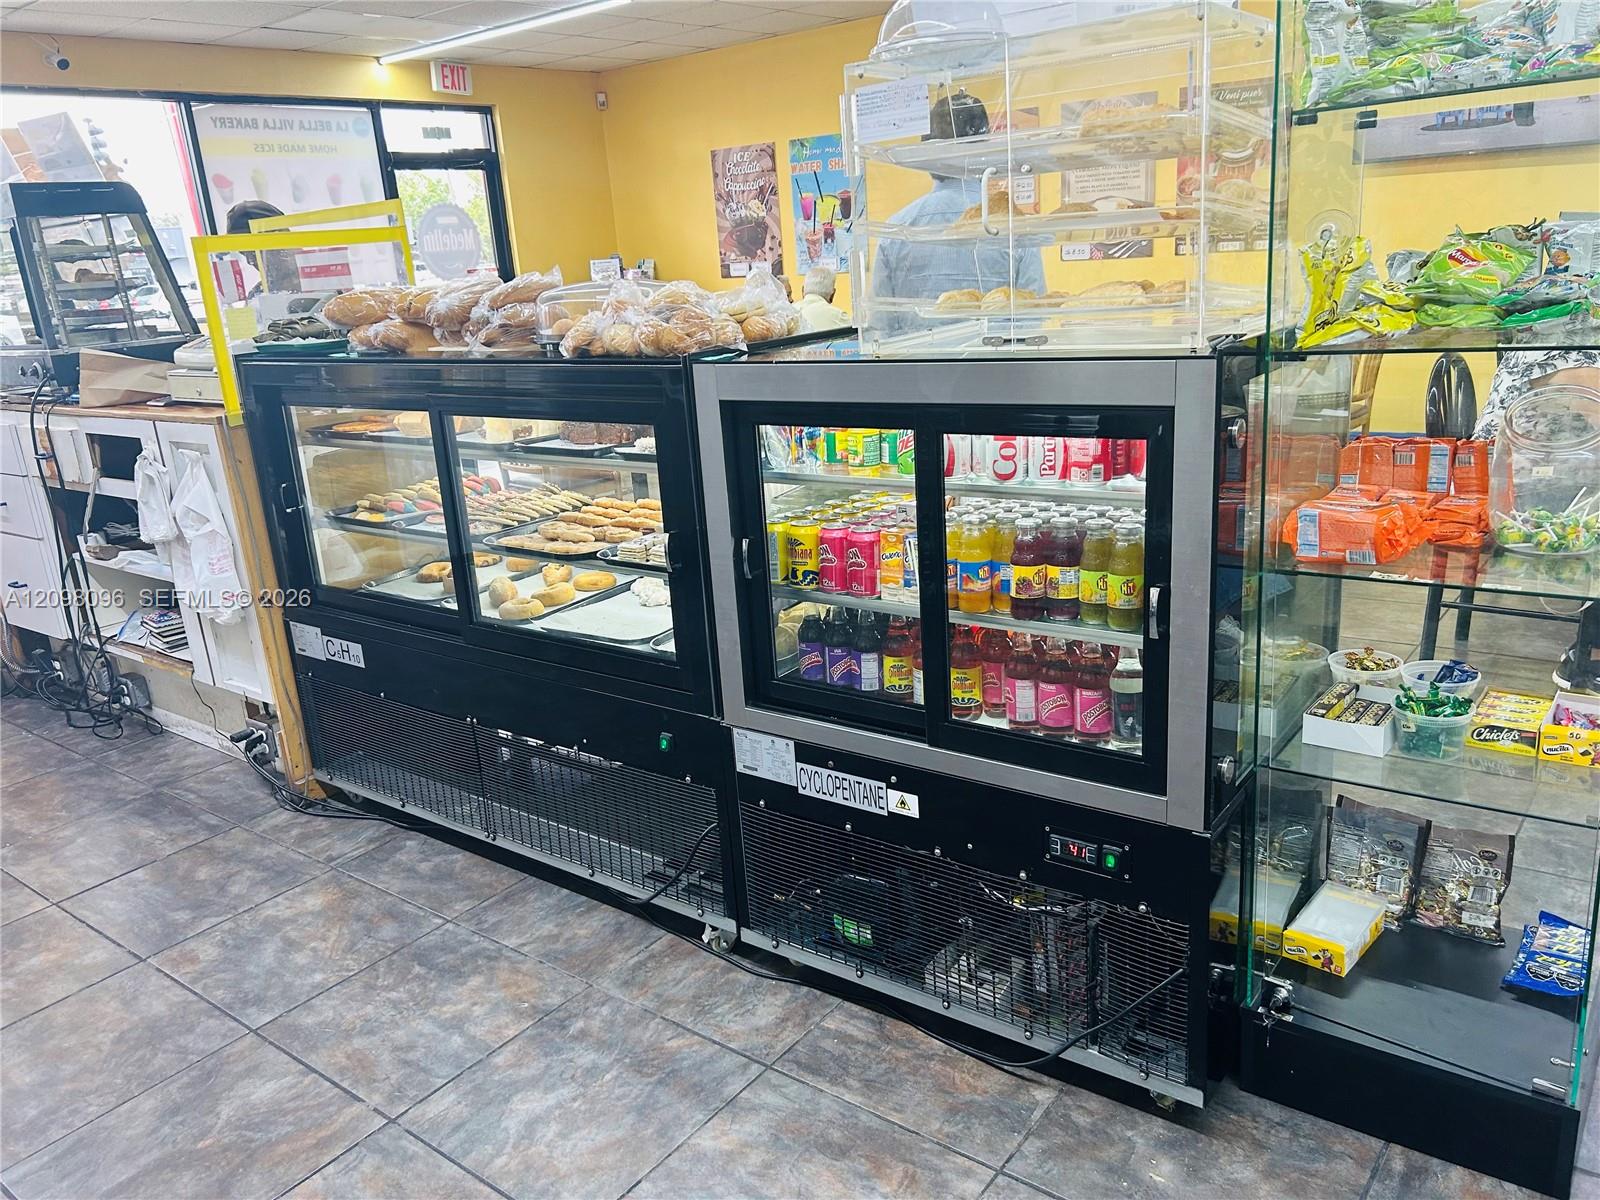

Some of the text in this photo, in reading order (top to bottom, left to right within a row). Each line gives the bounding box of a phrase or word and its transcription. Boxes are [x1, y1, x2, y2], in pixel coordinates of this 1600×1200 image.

[440, 63, 467, 92] EXIT
[733, 151, 751, 164] ICE
[726, 160, 761, 177] Chocolate
[790, 160, 822, 174] WATER
[724, 176, 766, 196] Cappuccino
[1472, 726, 1521, 742] Chiclets
[798, 766, 886, 811] CYCLOPENTANE
[1068, 843, 1086, 858] 41
